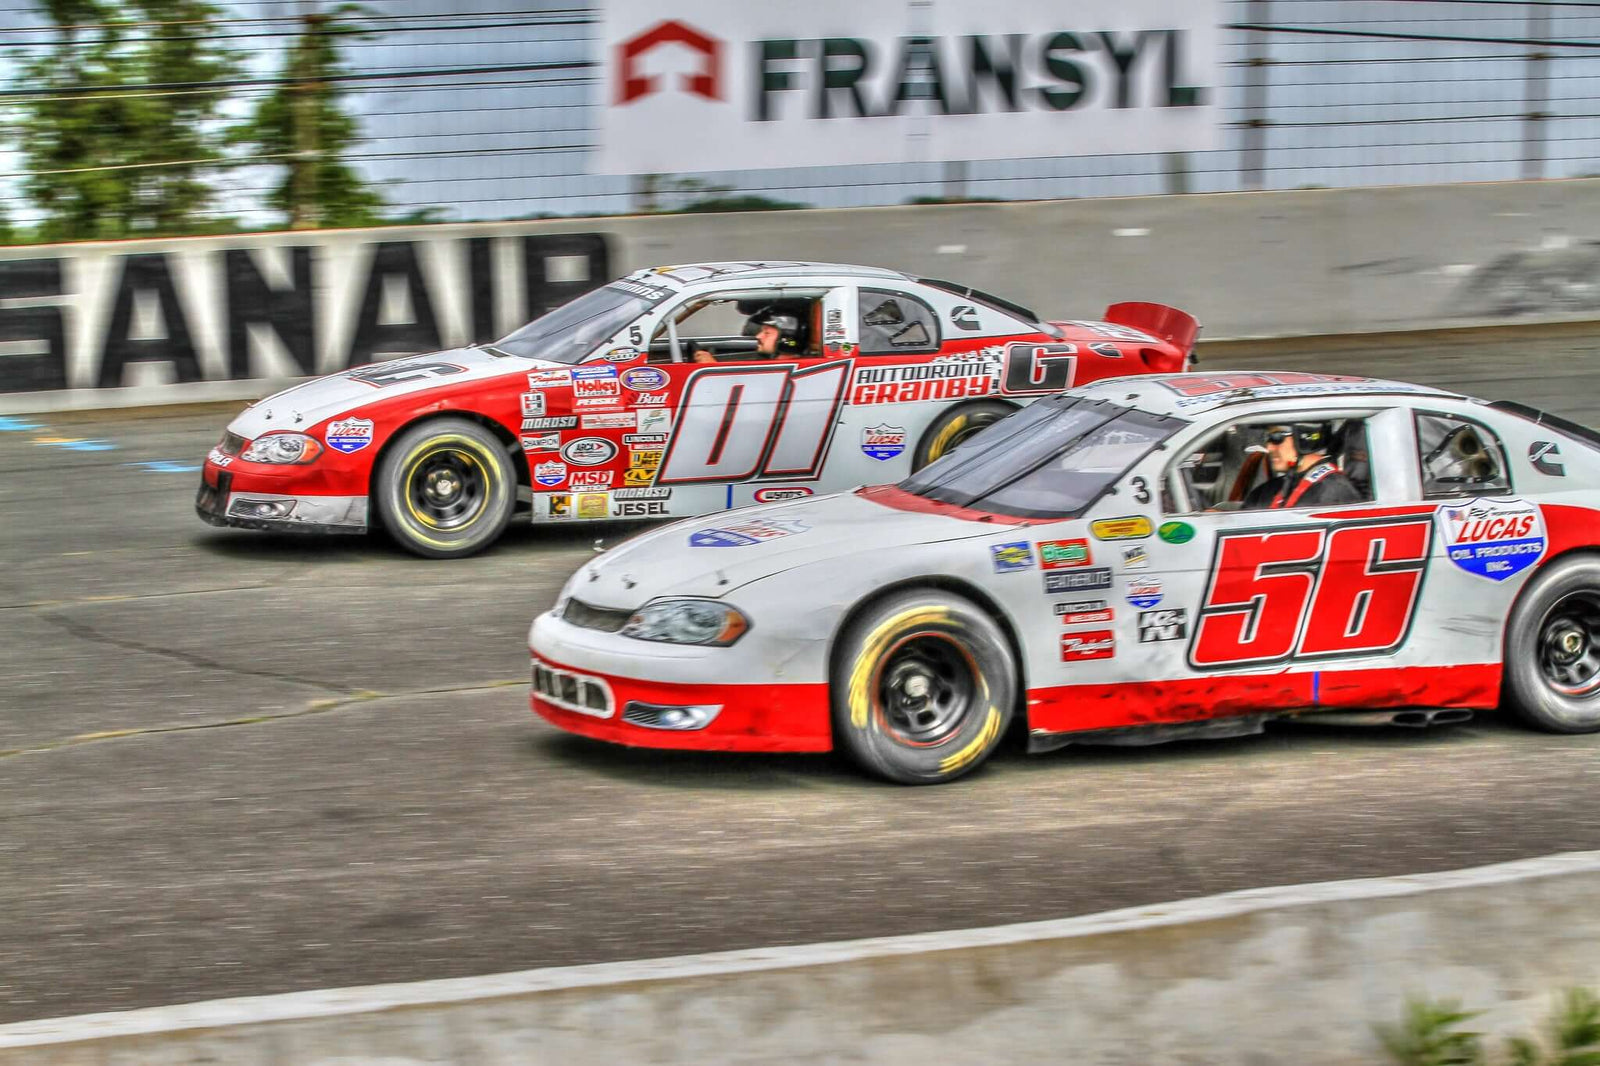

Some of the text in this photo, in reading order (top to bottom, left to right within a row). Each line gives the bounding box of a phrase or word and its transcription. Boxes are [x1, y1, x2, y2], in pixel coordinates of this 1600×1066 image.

[745, 29, 1213, 122] FRANSYL
[629, 325, 643, 346] 5
[856, 362, 994, 384] AUTODROME
[576, 379, 617, 395] Holley
[852, 375, 992, 406] GRANBY
[637, 392, 669, 404] Bud
[521, 417, 577, 430] MOROSO
[652, 358, 855, 487] 01
[332, 427, 369, 436] LUCAS
[866, 435, 904, 444] LUCAS
[522, 437, 559, 449] CHAMPION
[572, 471, 611, 485] MSD
[613, 487, 671, 499] MOROSO
[1131, 475, 1150, 504] 3
[612, 501, 670, 516] JESEL
[1455, 514, 1535, 544] LUCAS
[1451, 542, 1542, 560] OIL PRODUCTS
[1485, 560, 1513, 573] INC.
[1188, 513, 1434, 671] 56
